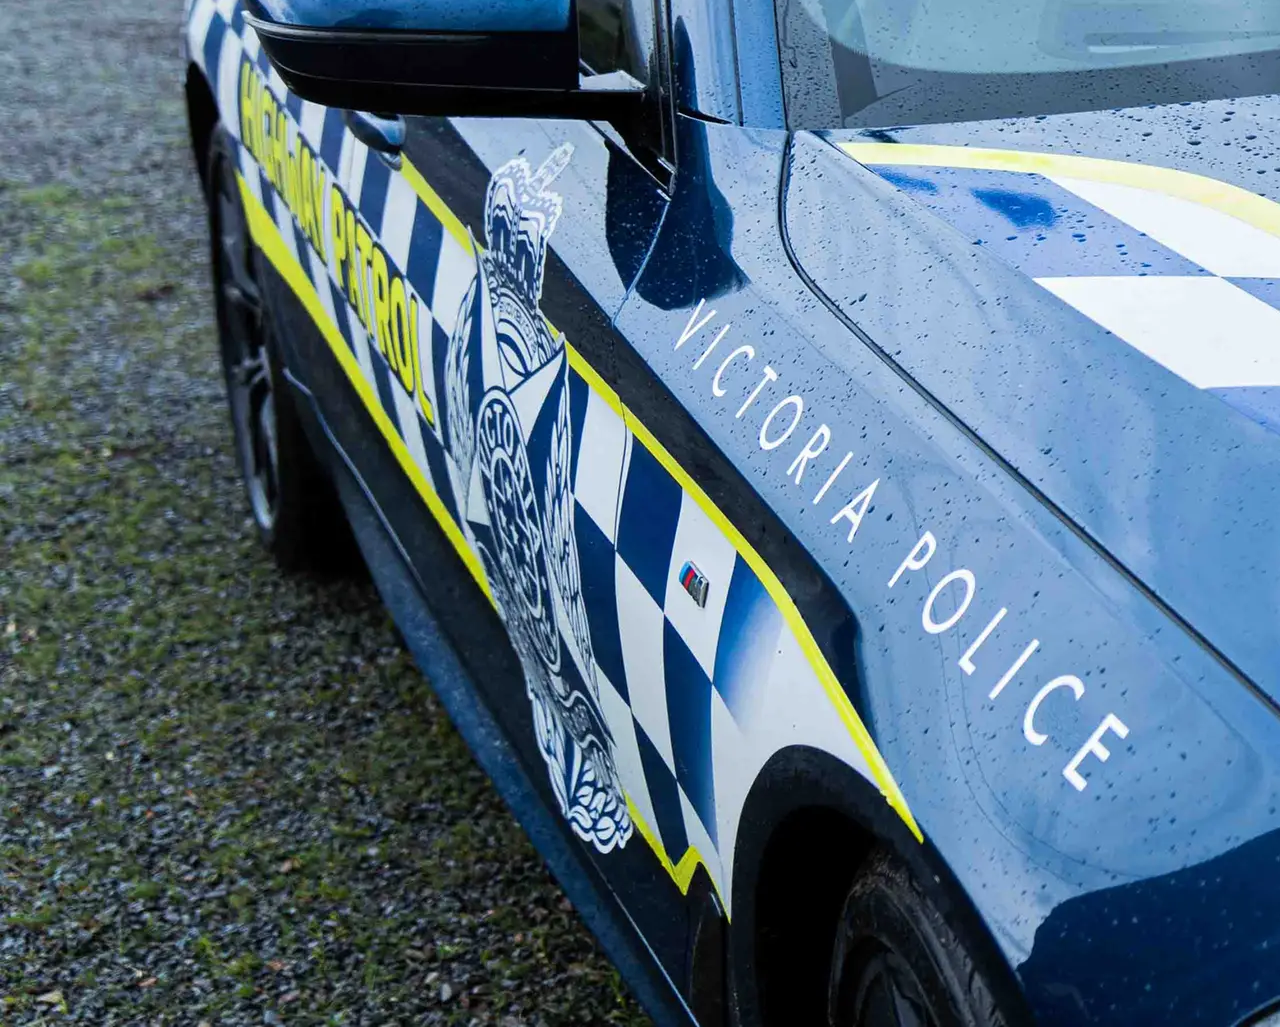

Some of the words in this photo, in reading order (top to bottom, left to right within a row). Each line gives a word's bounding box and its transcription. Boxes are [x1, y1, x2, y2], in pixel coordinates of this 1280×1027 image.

[330, 181, 436, 426] PATROL
[674, 298, 880, 542] VICTORIA
[887, 530, 1130, 792] POLICE
